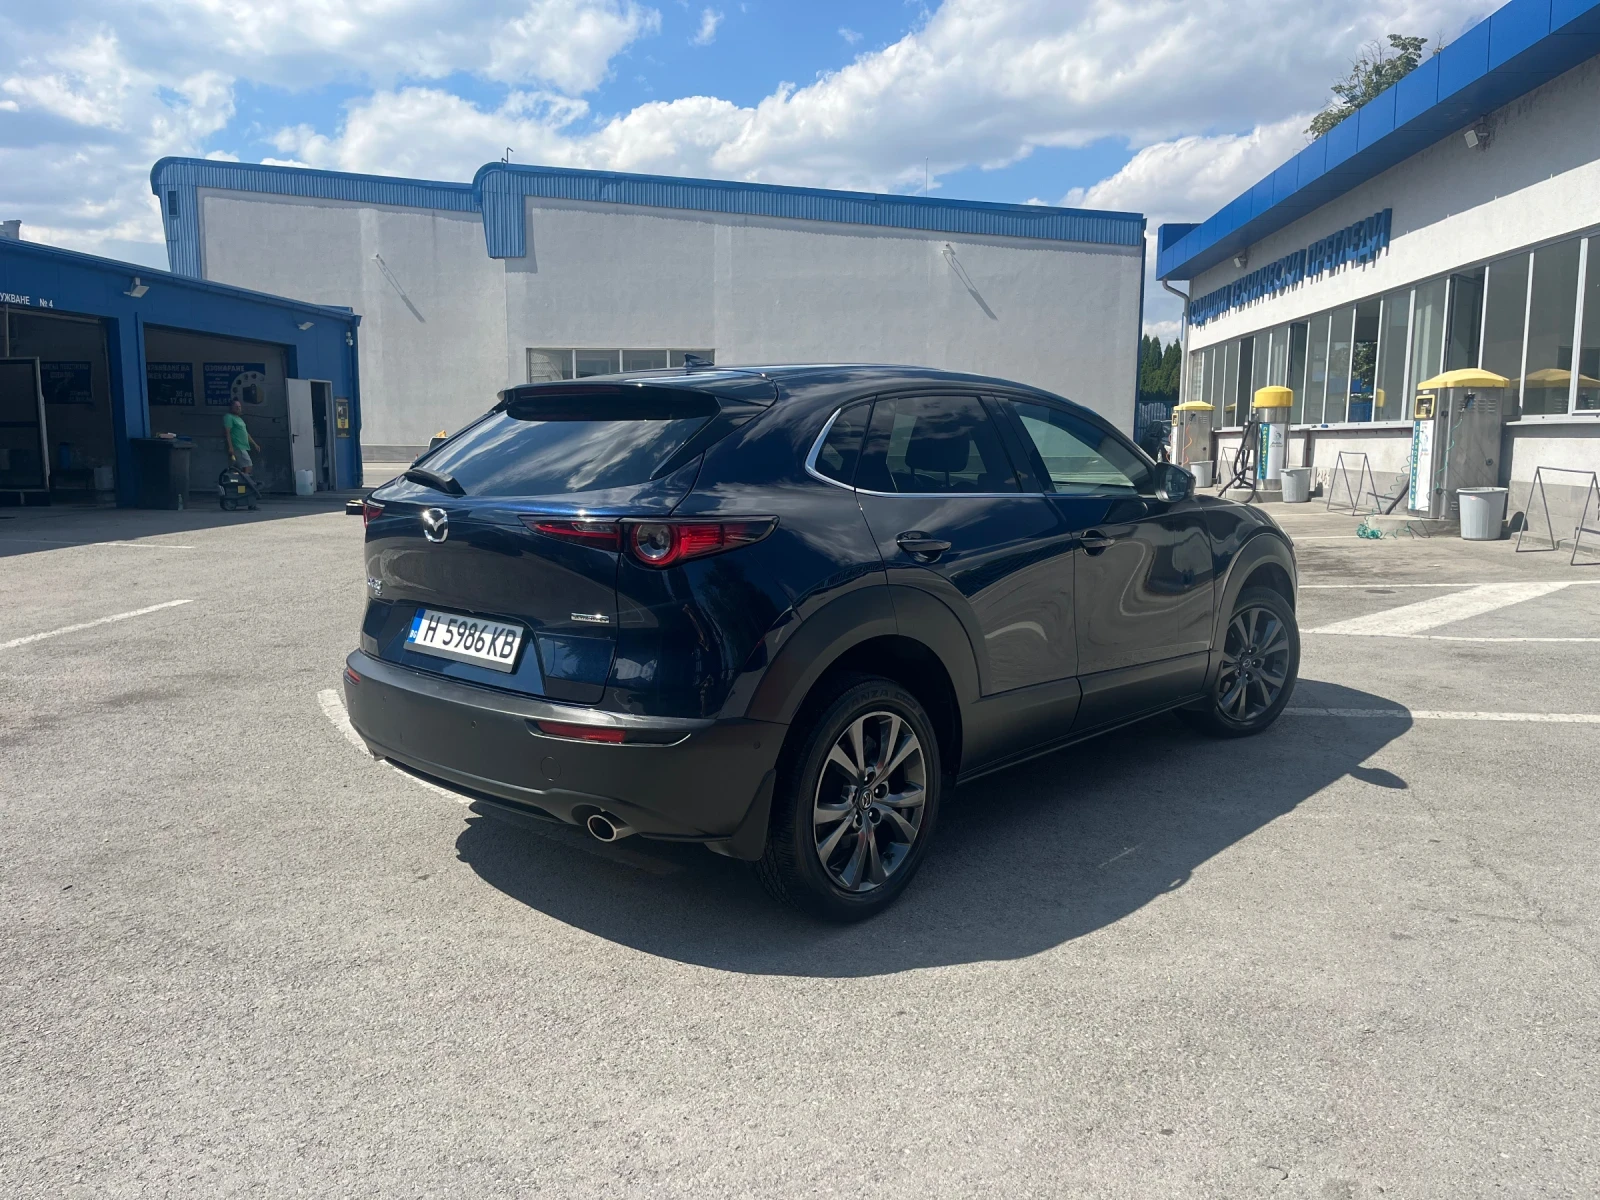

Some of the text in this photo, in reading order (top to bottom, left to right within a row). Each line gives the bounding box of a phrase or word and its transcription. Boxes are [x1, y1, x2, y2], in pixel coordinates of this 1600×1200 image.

[1231, 249, 1306, 308] ТЕХНИЧЕСКИ
[1306, 208, 1392, 278] ПРЕГЛЕДИ
[48, 299, 54, 308] 4
[409, 629, 418, 639] BG
[423, 614, 441, 643] H
